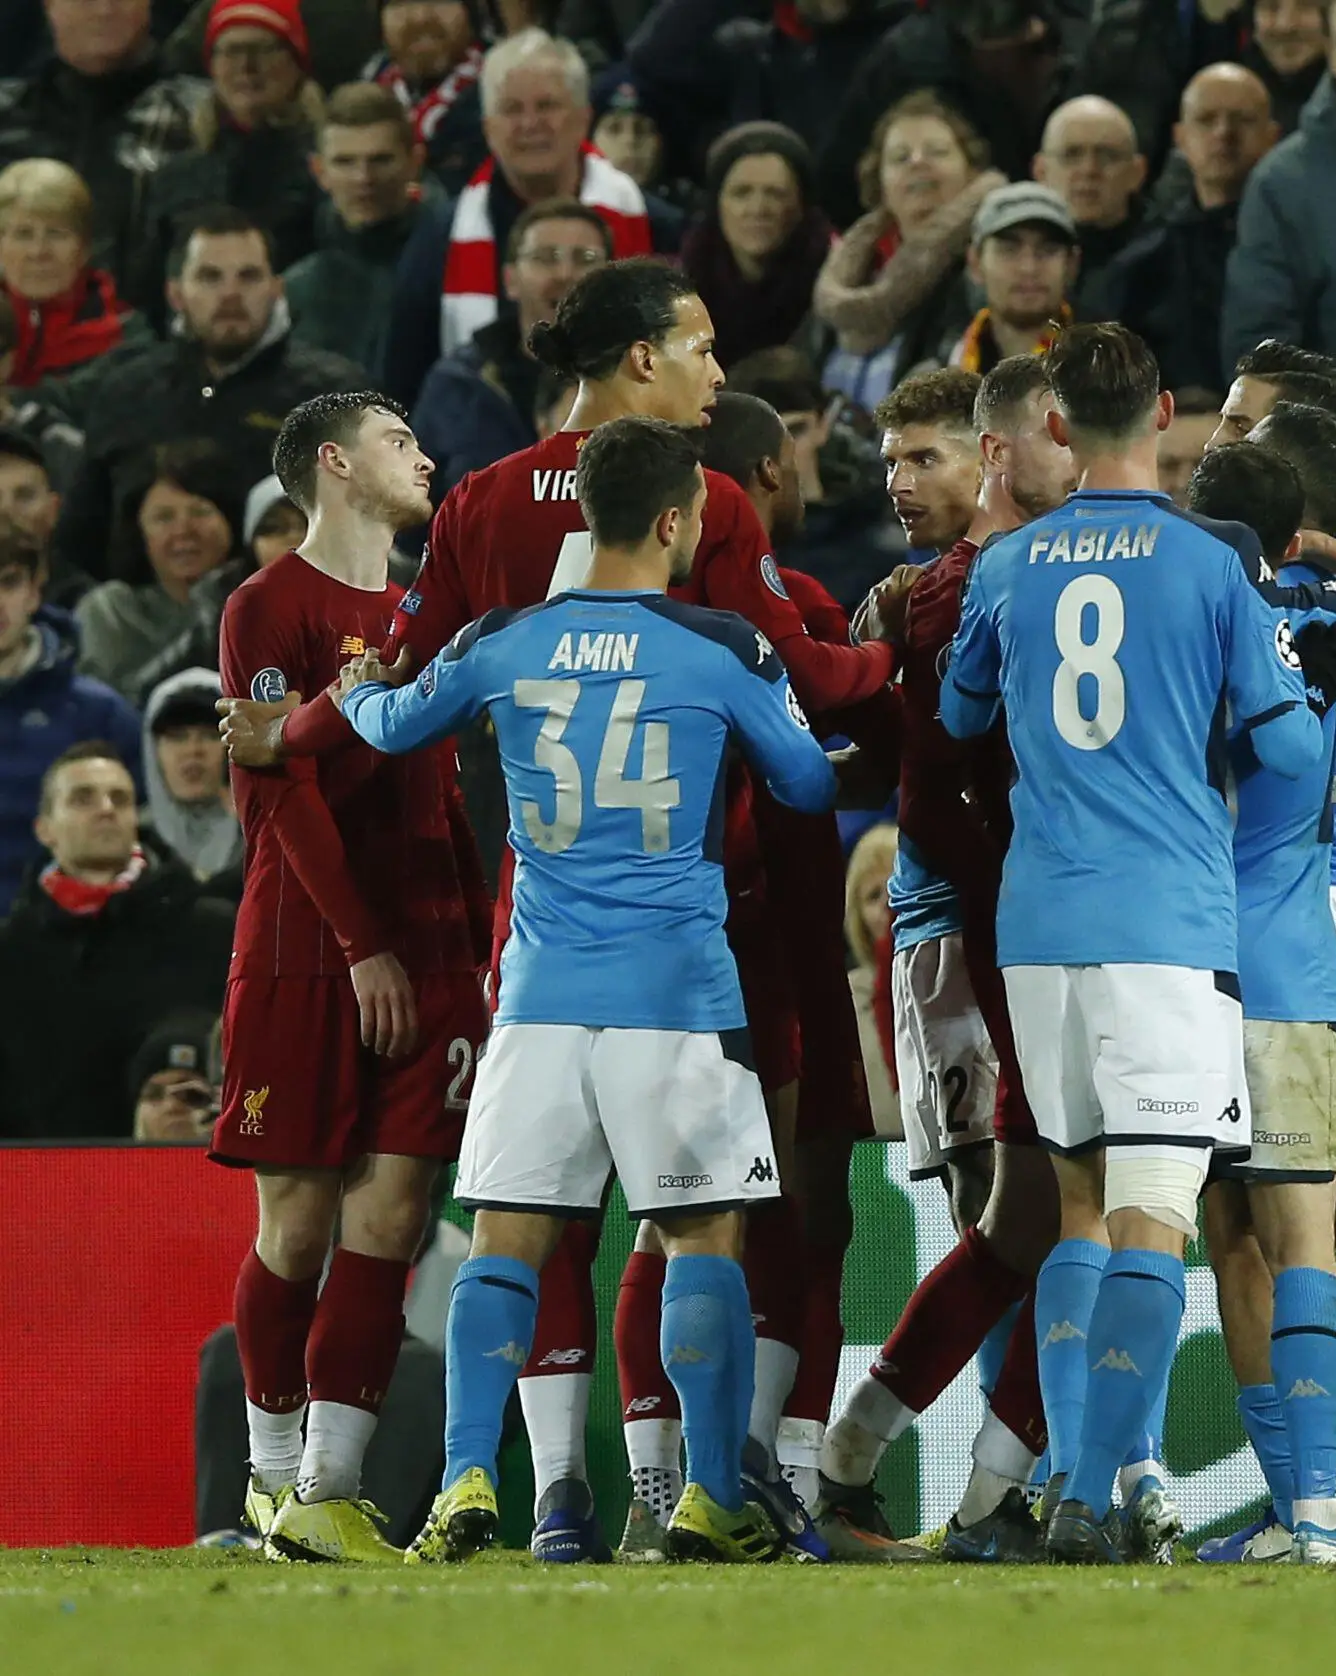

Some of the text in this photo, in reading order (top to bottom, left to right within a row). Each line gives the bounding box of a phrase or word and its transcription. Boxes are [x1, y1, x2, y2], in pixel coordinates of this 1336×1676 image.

[1028, 524, 1162, 565] FABIAN
[547, 632, 638, 672] AMIN
[1052, 573, 1126, 751] 8
[513, 678, 681, 854] 34
[1136, 1097, 1200, 1115] Kappa
[239, 1122, 265, 1136] LFC
[1252, 1129, 1312, 1145] Kappa
[658, 1173, 713, 1189] Kappa
